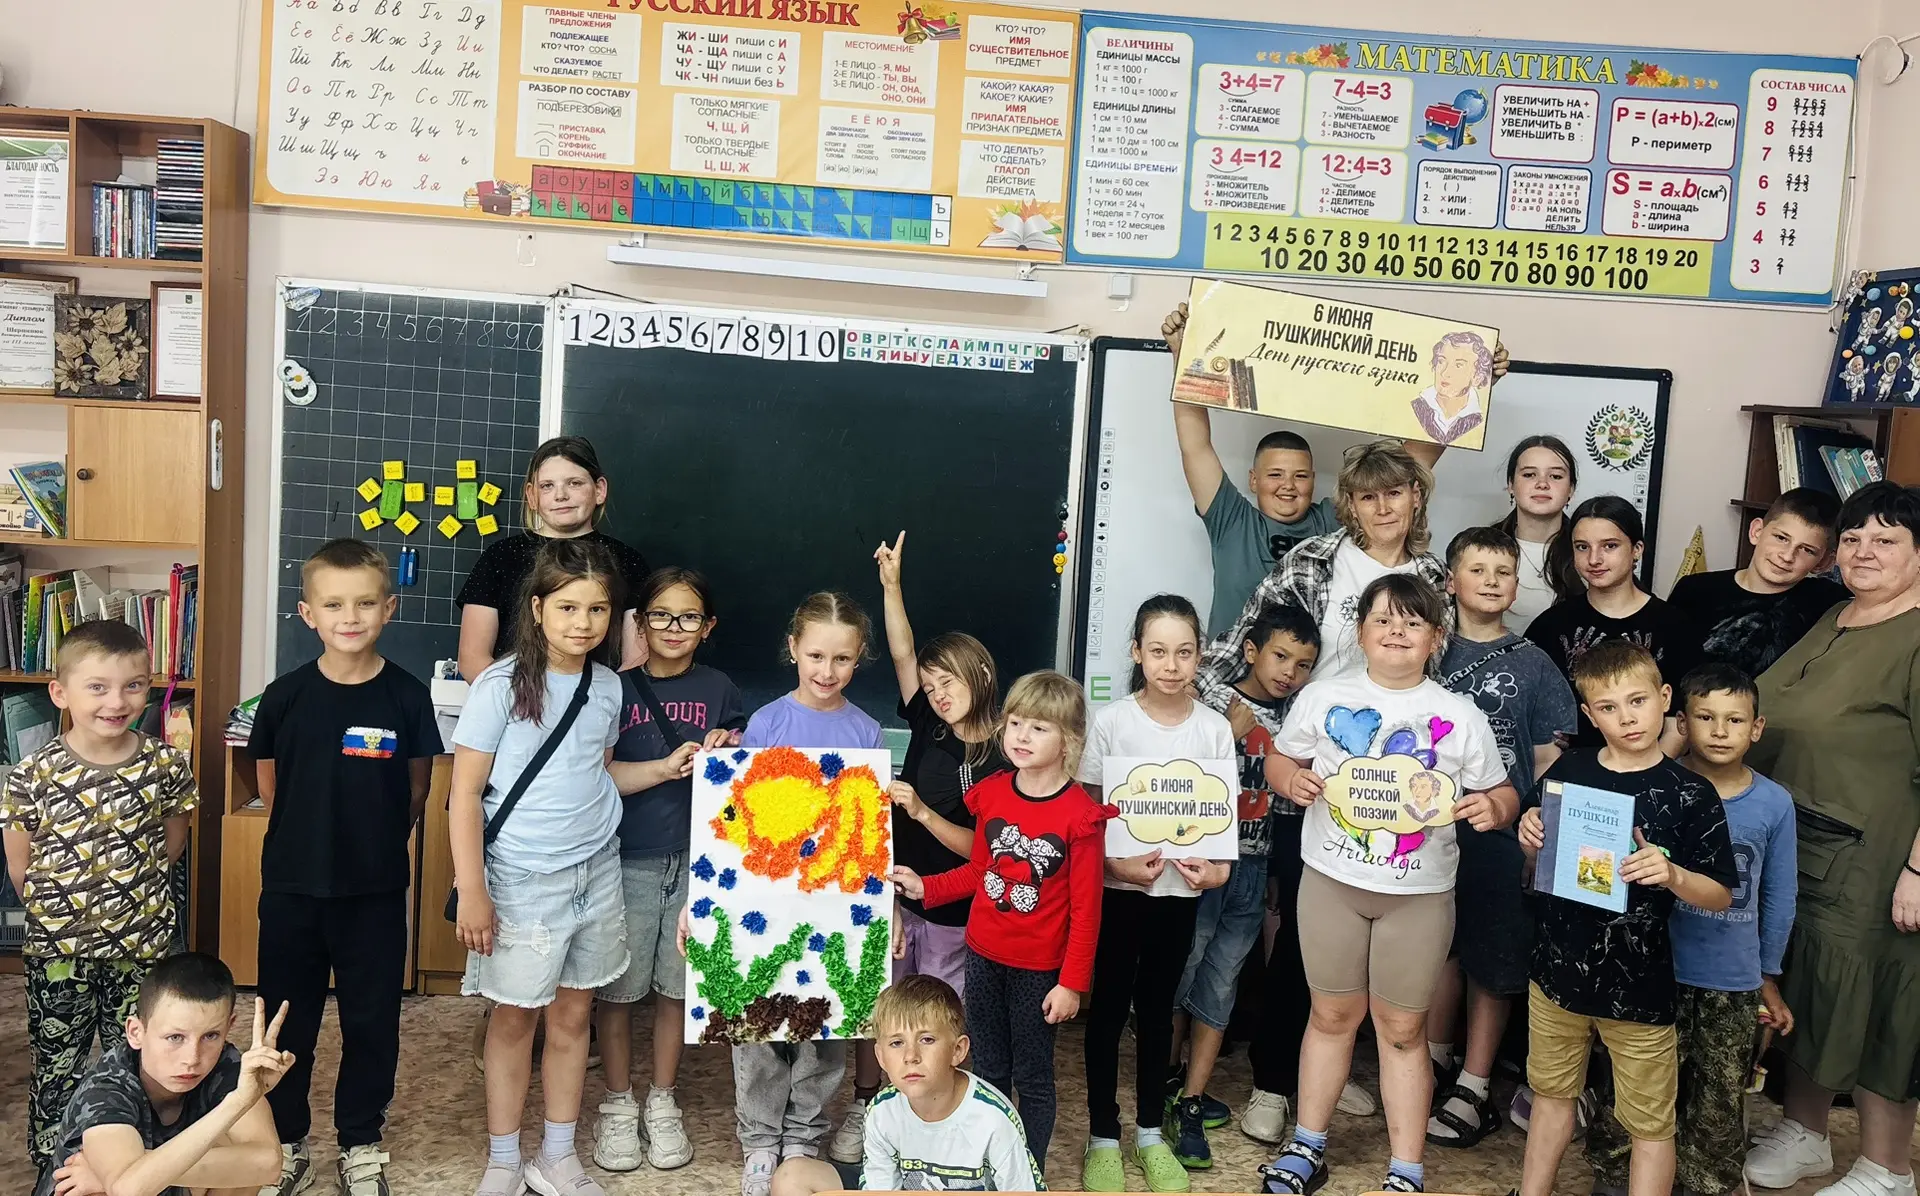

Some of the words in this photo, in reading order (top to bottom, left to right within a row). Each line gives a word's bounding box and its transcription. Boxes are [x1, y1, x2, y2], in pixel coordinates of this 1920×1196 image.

[545, 8, 584, 19] ГЛАВНЫЕ
[587, 11, 616, 20] ЧЛЕНЫ
[767, 0, 860, 26] ЯЗЫК
[549, 18, 612, 29] ПРЕДЛОЖЕНИЯ
[995, 24, 1019, 34] КТО?
[1021, 25, 1045, 35] ЧТО?
[550, 31, 609, 43] ПОДЛЕЖАЩЕЕ
[677, 30, 696, 41] ЖИ
[708, 33, 728, 43] ШИ
[735, 37, 765, 47] пиши
[778, 38, 787, 49] И
[1009, 36, 1030, 45] ИМЯ
[541, 42, 561, 51] КТО?
[564, 44, 584, 52] ЧТО?
[589, 45, 617, 55] СОСНА
[845, 41, 914, 53] МЕСТОИМЕНИЕ
[1107, 38, 1174, 51] ВЕЛИЧИНЫ
[969, 44, 1069, 59] СУЩЕСТВИТЕЛЬНОЕ
[1097, 51, 1143, 61] ЕДИНИЦЫ
[1146, 55, 1180, 64] МАССЫ
[554, 57, 603, 67] СКАЗУЕМОЕ
[835, 60, 847, 69] 1-Е
[850, 61, 876, 71] ЛИЦО
[895, 65, 911, 73] МЫ
[996, 57, 1041, 68] ПРЕДМЕТ
[1355, 42, 1617, 84] МАТЕМАТИКА
[533, 66, 550, 74] ЧТО
[551, 67, 588, 77] ДЕЛАЕТ?
[592, 70, 623, 79] РАСТЕТ
[834, 70, 847, 79] 2-Е
[849, 71, 876, 81] ЛИЦО
[902, 75, 917, 83] ВЫ
[676, 71, 691, 81] ЧК
[702, 72, 718, 83] ЧН
[722, 76, 751, 86] пиши
[754, 77, 773, 88] без
[777, 79, 785, 88] Ь
[833, 80, 847, 89] 3-Е
[849, 81, 875, 91] ЛИЦО
[1219, 71, 1285, 92] 3+4=7
[529, 84, 567, 94] РАЗБОР
[570, 87, 584, 95] ПО
[586, 88, 630, 98] СОСТАВУ
[980, 81, 1017, 92] КАКОЙ?
[1019, 83, 1054, 93] КАКАЯ?
[1333, 79, 1391, 100] 7-4=3
[1761, 80, 1806, 91] СОСТАВ
[1809, 82, 1846, 94] ЧИСЛА
[906, 95, 926, 104] ОНИ
[980, 92, 1016, 102] КАКОЕ?
[1018, 94, 1053, 104] КАКИЕ?
[1504, 96, 1564, 107] УВЕЛИЧИТЬ
[1567, 99, 1581, 107] НА
[537, 102, 620, 116] ПОДБЕРЕЗОВИКИ
[690, 98, 728, 108] ТОЛЬКО
[730, 101, 768, 111] МЯГКИЕ
[1005, 104, 1026, 112] ИМЯ
[1093, 101, 1140, 112] ЕДИНИЦЫ
[1142, 105, 1176, 115] ДЛИНЫ
[1231, 105, 1281, 115] СЛАГАЕМОЕ
[698, 108, 759, 119] СОГЛАСНЫЕ:
[971, 112, 1059, 126] ПРИЛАГАТЕЛЬНОЕ
[1230, 114, 1280, 124] СЛАГАЕМОЕ
[1334, 112, 1399, 123] УМЕНЬШАЕМОЕ
[1503, 107, 1567, 119] УМЕНЬШИТЬ
[1570, 111, 1583, 119] НА
[559, 125, 606, 134] ПРИСТАВКА
[1230, 124, 1259, 132] СУММА
[1333, 121, 1391, 132] ВЫЧЕТАЕМОЕ
[1502, 118, 1562, 129] УВЕЛИЧИТЬ
[1565, 122, 1571, 130] В
[966, 123, 1010, 134] ПРИЗНАК
[1012, 126, 1062, 138] ПРЕДМЕТА
[1332, 131, 1376, 140] РАЗНОСТЬ
[1501, 129, 1565, 140] УМЕНЬШИТЬ
[1568, 133, 1574, 141] В
[559, 133, 590, 141] КОРЕНЬ
[684, 135, 722, 145] ТОЛЬКО
[725, 138, 769, 150] ТВЕРДЫЕ
[558, 141, 597, 150] СУФФИКС
[696, 146, 757, 157] СОГЛАСНЫЕ:
[983, 144, 1002, 153] ЧТО
[1003, 145, 1044, 156] ДЕЛАТЬ?
[1651, 139, 1712, 152] периметр
[558, 150, 607, 160] ОКОНЧАНИЕ
[979, 155, 998, 163] ЧТО
[1000, 156, 1046, 167] СДЕЛАТЬ?
[1085, 160, 1131, 170] ЕДИНИЦЫ
[1134, 163, 1178, 172] ВРЕМЕНИ
[1322, 153, 1392, 175] 12:4=3
[1424, 166, 1452, 174] ПОРЯДОК
[994, 166, 1030, 175] ГЛАГОЛ
[986, 175, 1036, 186] ДЕЙСТВИЕ
[1544, 173, 1588, 181] УМНОЖЕНИЯ
[986, 186, 1036, 197] ПРЕДМЕТА
[1216, 181, 1269, 191] МНОЖИТЕЛЬ
[1216, 191, 1269, 200] МНОЖИТЕЛЬ
[1336, 189, 1376, 198] ДЕЛИМОЕ
[1219, 200, 1286, 211] ПРОИЗВЕДЕНИЕ
[1330, 198, 1375, 207] ДЕЛИТЕЛЬ
[1651, 202, 1699, 212] площадь
[1546, 215, 1581, 223] ДЕЛИТЬ
[1648, 212, 1681, 221] длина
[1545, 223, 1576, 231] НЕЛЬЗЯ
[1648, 222, 1689, 232] ширина
[1261, 247, 1289, 269] 10
[1298, 250, 1328, 271] 20
[1337, 252, 1366, 274] 30
[1374, 254, 1404, 276] 40
[1413, 257, 1443, 278] 50
[1451, 258, 1481, 281] 60
[1490, 260, 1519, 283] 70
[1527, 263, 1556, 285] 80
[1565, 265, 1595, 287] 90
[1605, 267, 1648, 290] 100
[1313, 304, 1324, 322] 6
[1328, 306, 1373, 331] ИЮНЯ
[1263, 321, 1373, 356] ПУШКИНСКИЙ
[1375, 339, 1418, 363] ДЕНЬ
[1247, 342, 1291, 364] День
[1292, 355, 1365, 377] русского
[1367, 366, 1419, 389] языка
[1351, 767, 1398, 784] СОЛНЦЕ
[1151, 779, 1158, 792] 6
[1161, 777, 1193, 793] ИЮНЯ
[1349, 785, 1400, 803] РУССКОЙ
[1117, 798, 1197, 816] ПУШКИНСКИЙ
[1199, 801, 1228, 817] ДЕНЬ
[1353, 806, 1398, 821] ПОЭЗИИ
[1568, 808, 1619, 826] ПУШКИН
[1674, 900, 1713, 919] REEDOM
[1715, 911, 1724, 920] IS
